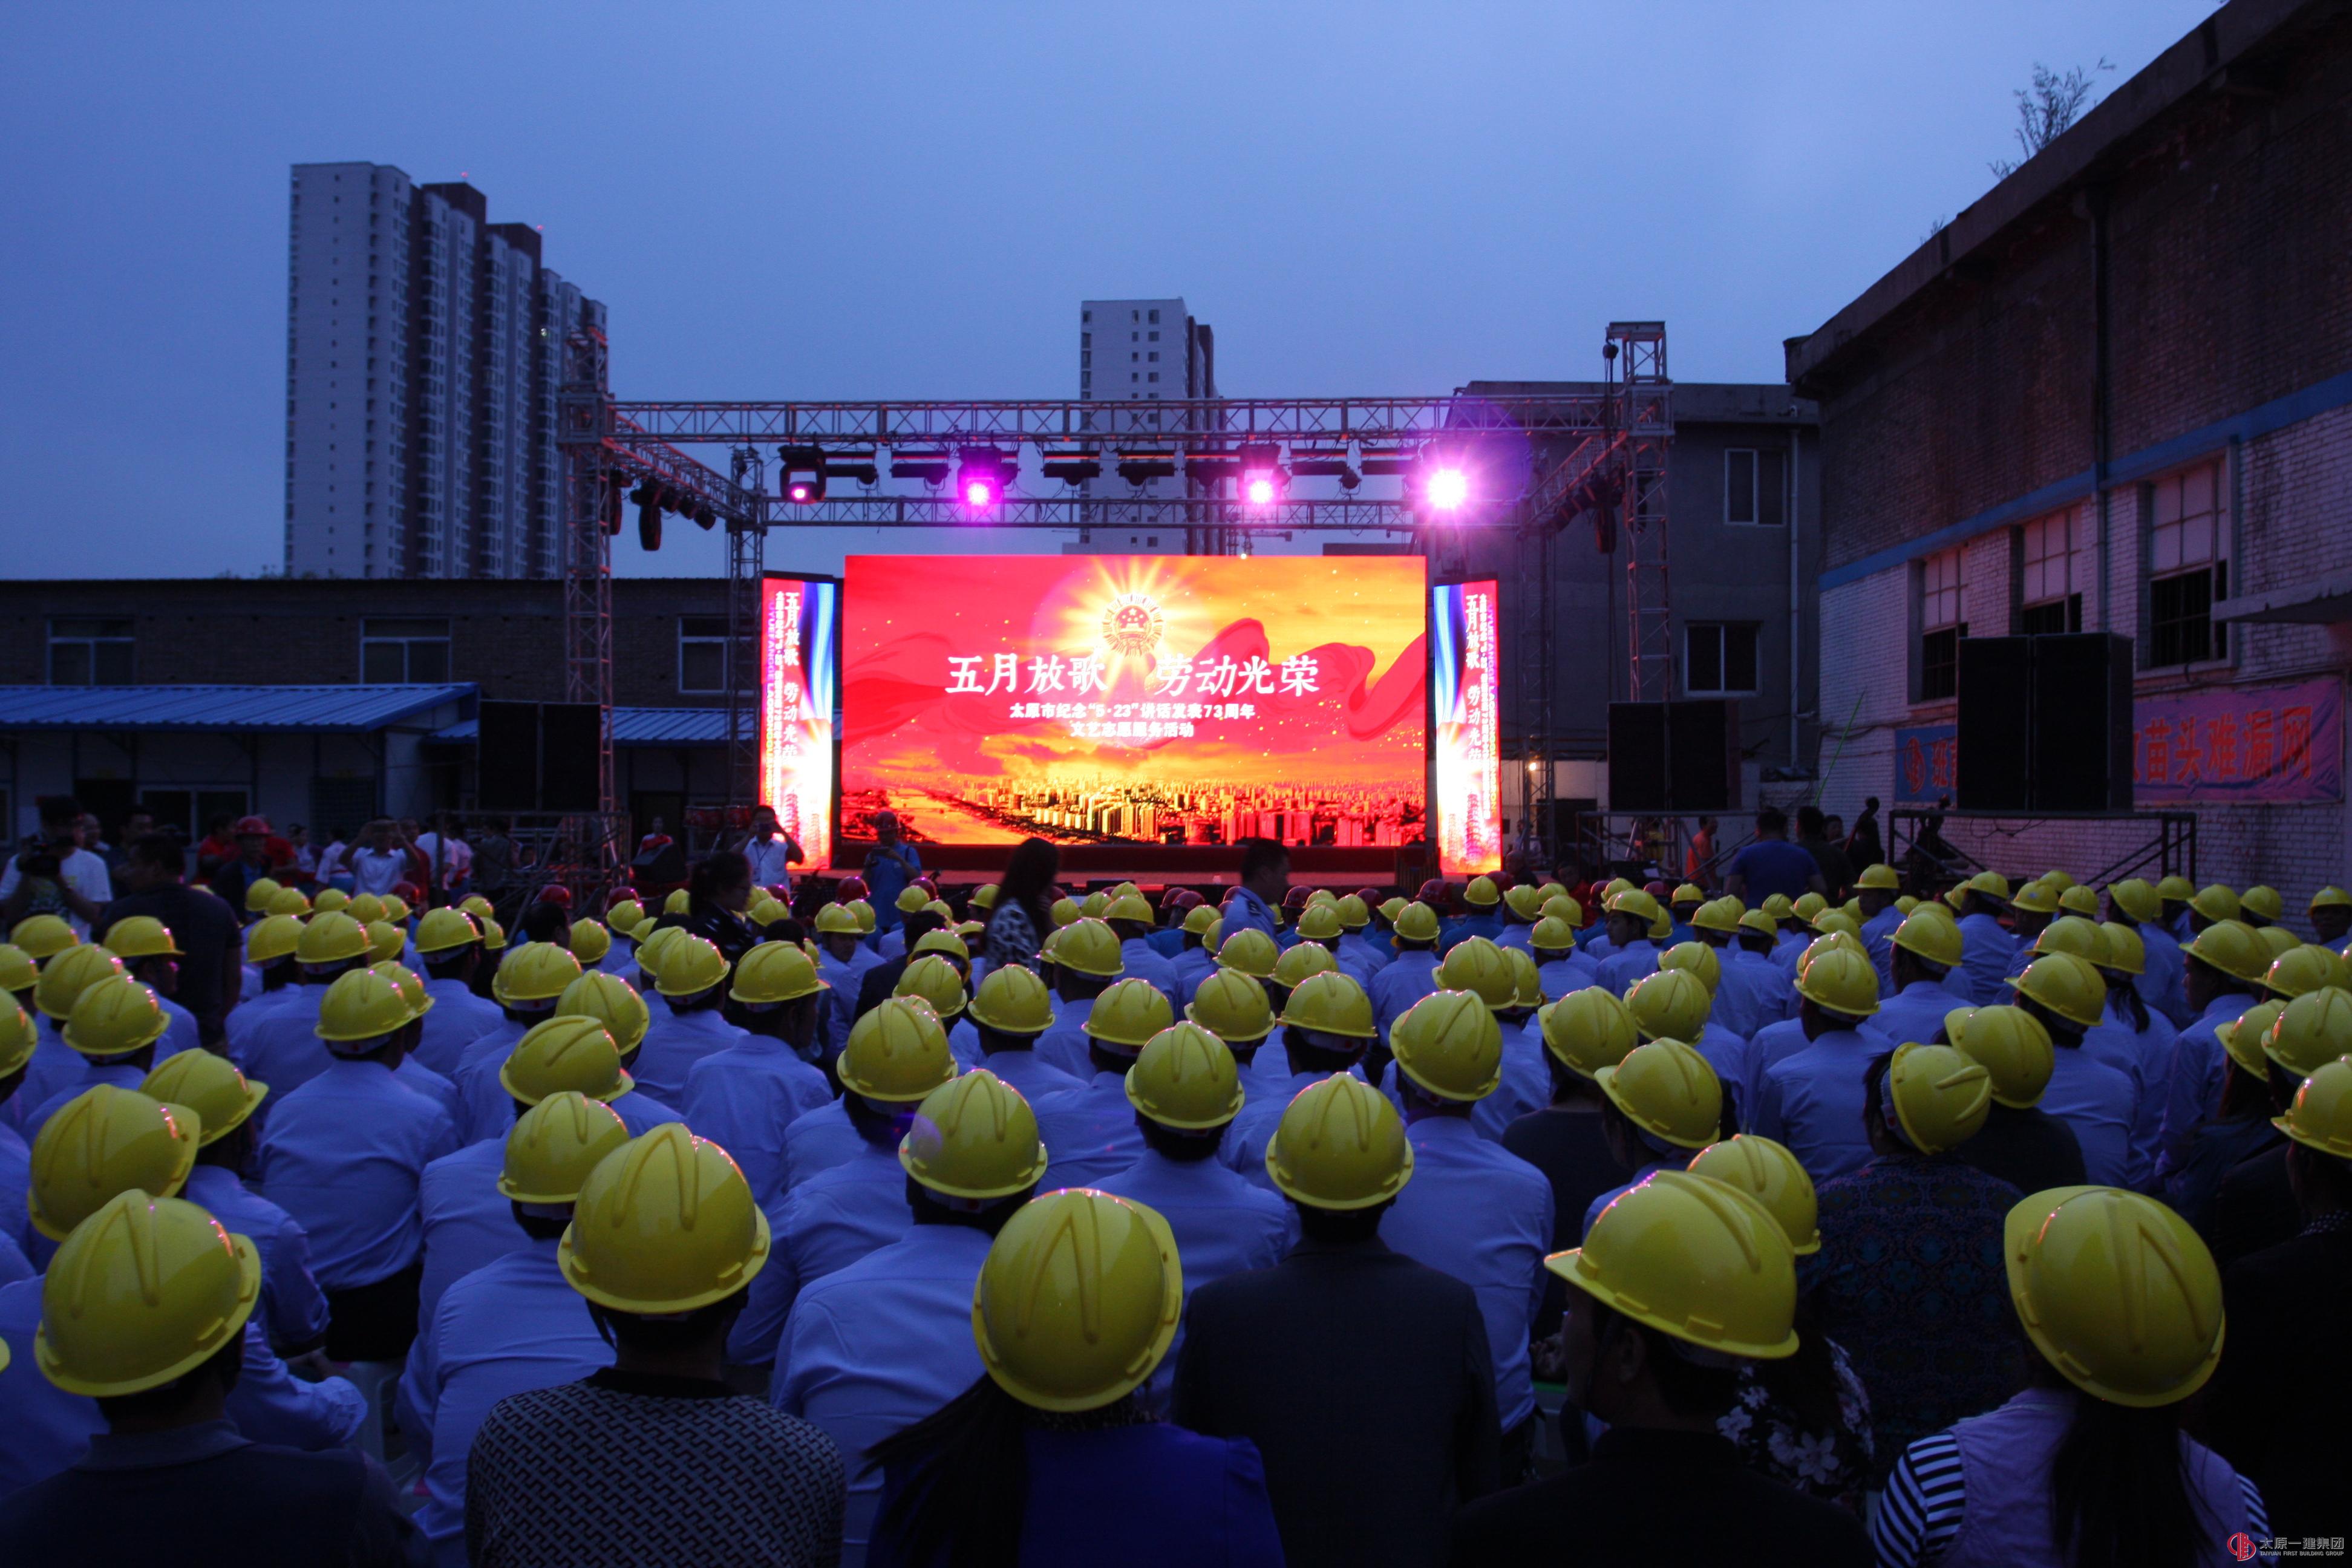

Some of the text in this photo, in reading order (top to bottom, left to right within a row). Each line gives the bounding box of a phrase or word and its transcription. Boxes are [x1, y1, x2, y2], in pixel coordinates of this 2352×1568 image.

[783, 592, 800, 666] 五月放歌
[1466, 594, 1480, 669] 五月放歌
[944, 650, 1320, 697] 五月放歌 劳动光荣
